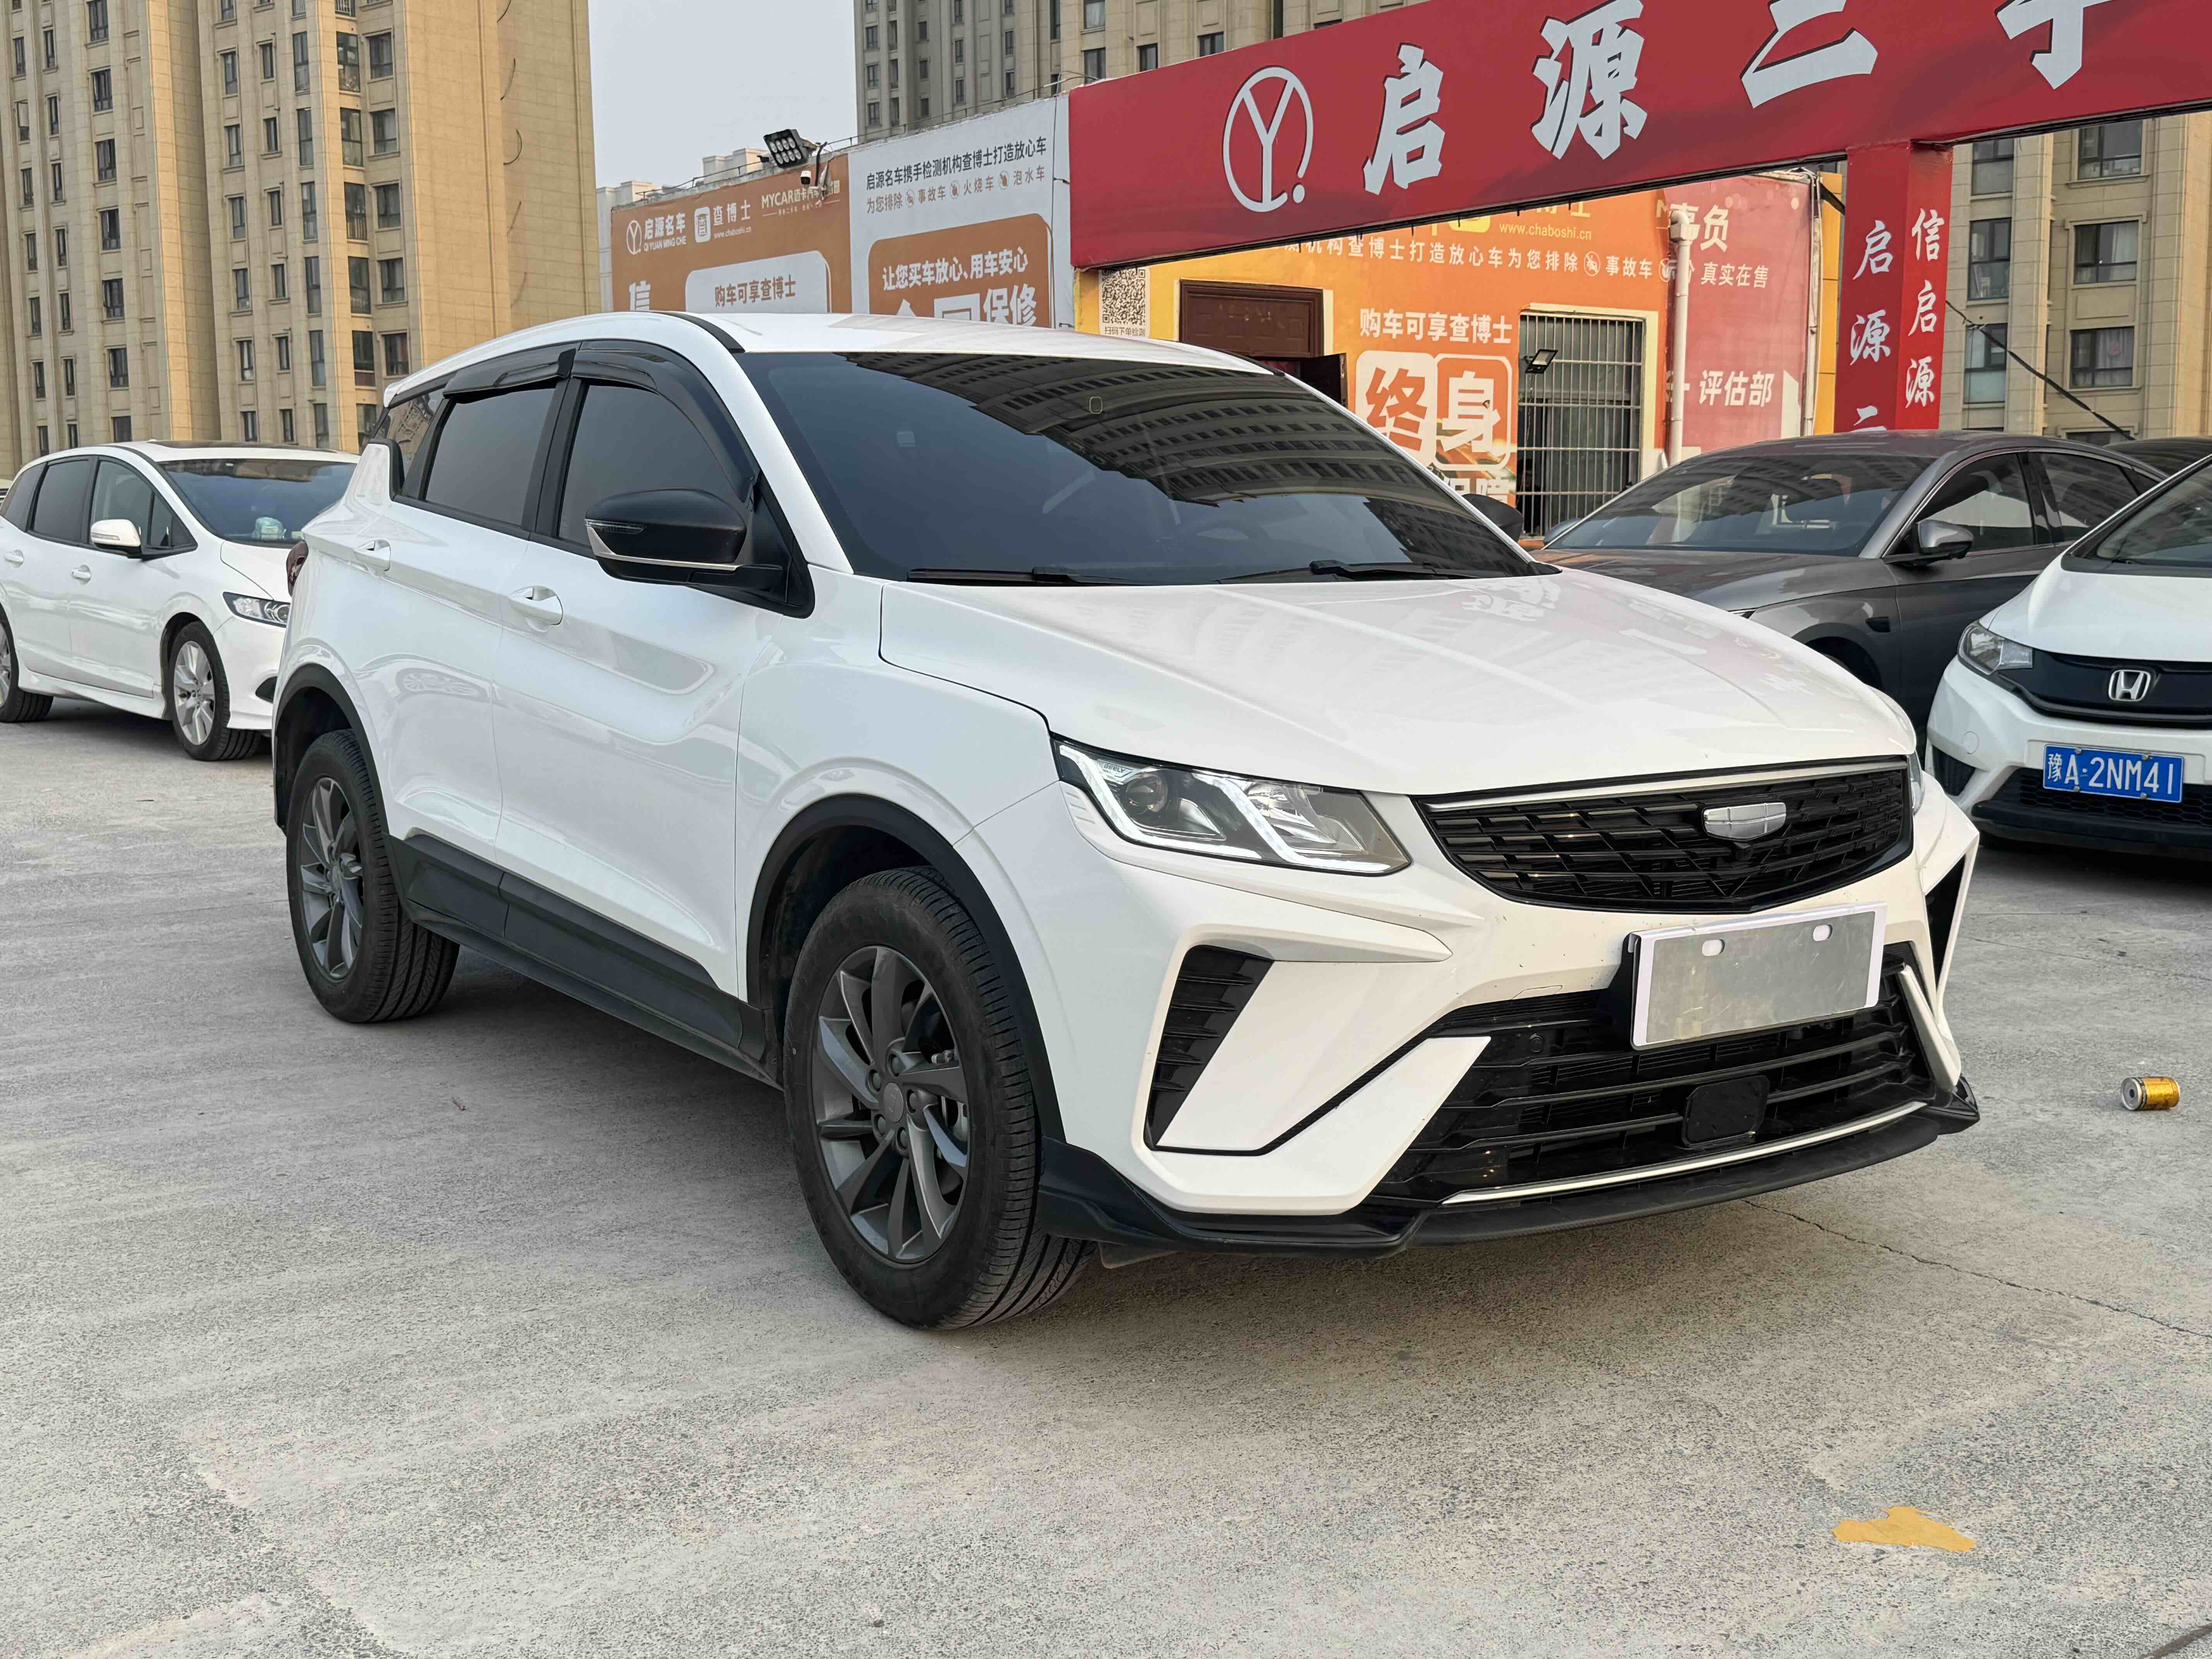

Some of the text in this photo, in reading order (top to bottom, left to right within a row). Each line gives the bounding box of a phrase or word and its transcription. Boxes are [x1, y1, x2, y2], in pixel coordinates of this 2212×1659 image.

[867, 136, 1046, 190] 启源名车携手检测机构查博士打造放心车
[867, 165, 1045, 214] 为您排除 事故车 火烧车 泡水车
[644, 213, 685, 240] 启源名车
[713, 199, 751, 226] 查博士
[1499, 223, 1591, 240] www.chaboshi.cn
[883, 246, 1028, 291] 让您买车放心、用车安心
[1606, 256, 1652, 278] 事故车
[1701, 261, 1769, 288] 真实在售
[714, 275, 796, 307] 购车可享查博士
[1360, 308, 1512, 344] 购车可享查博士
[1365, 368, 1504, 454] 终身
